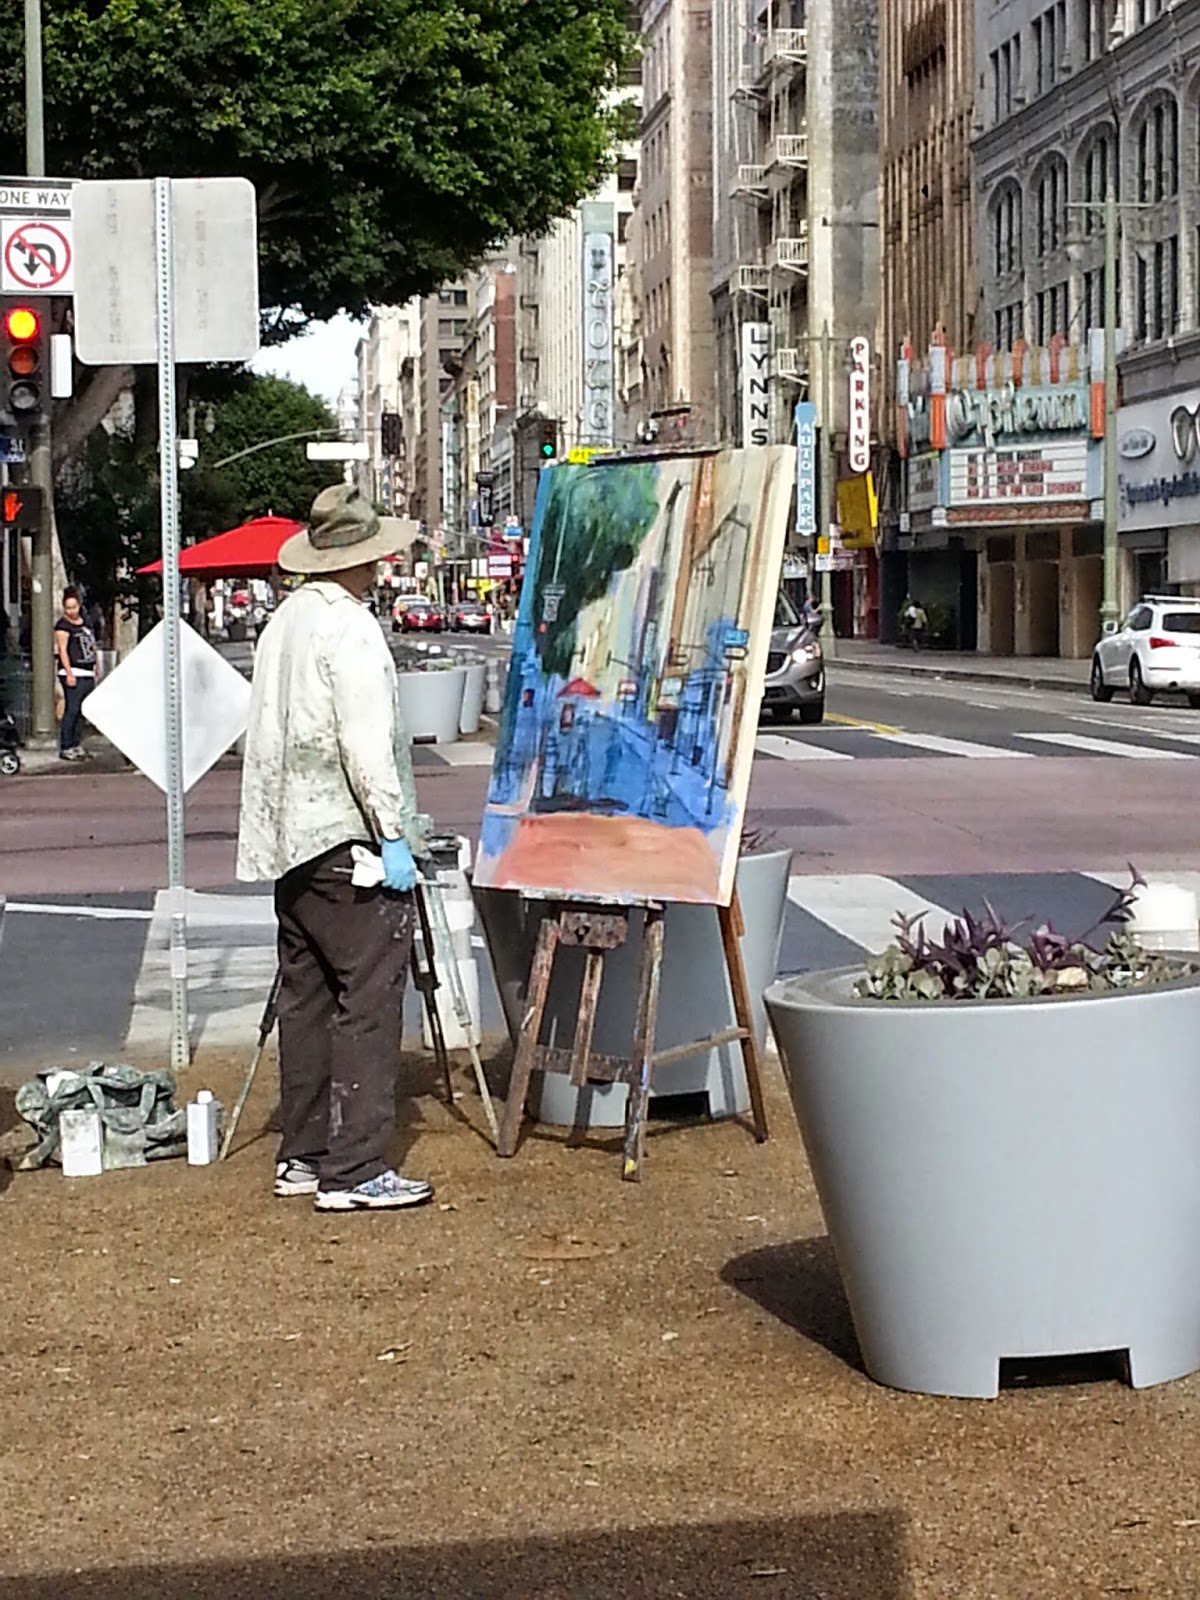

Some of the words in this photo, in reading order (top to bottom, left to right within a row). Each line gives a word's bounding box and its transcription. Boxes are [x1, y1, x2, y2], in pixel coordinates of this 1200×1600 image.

[0, 190, 30, 205] ONE
[37, 192, 70, 206] WAY
[750, 328, 769, 446] LYNNS
[854, 343, 866, 467] PARKING
[800, 422, 812, 471] AUTO
